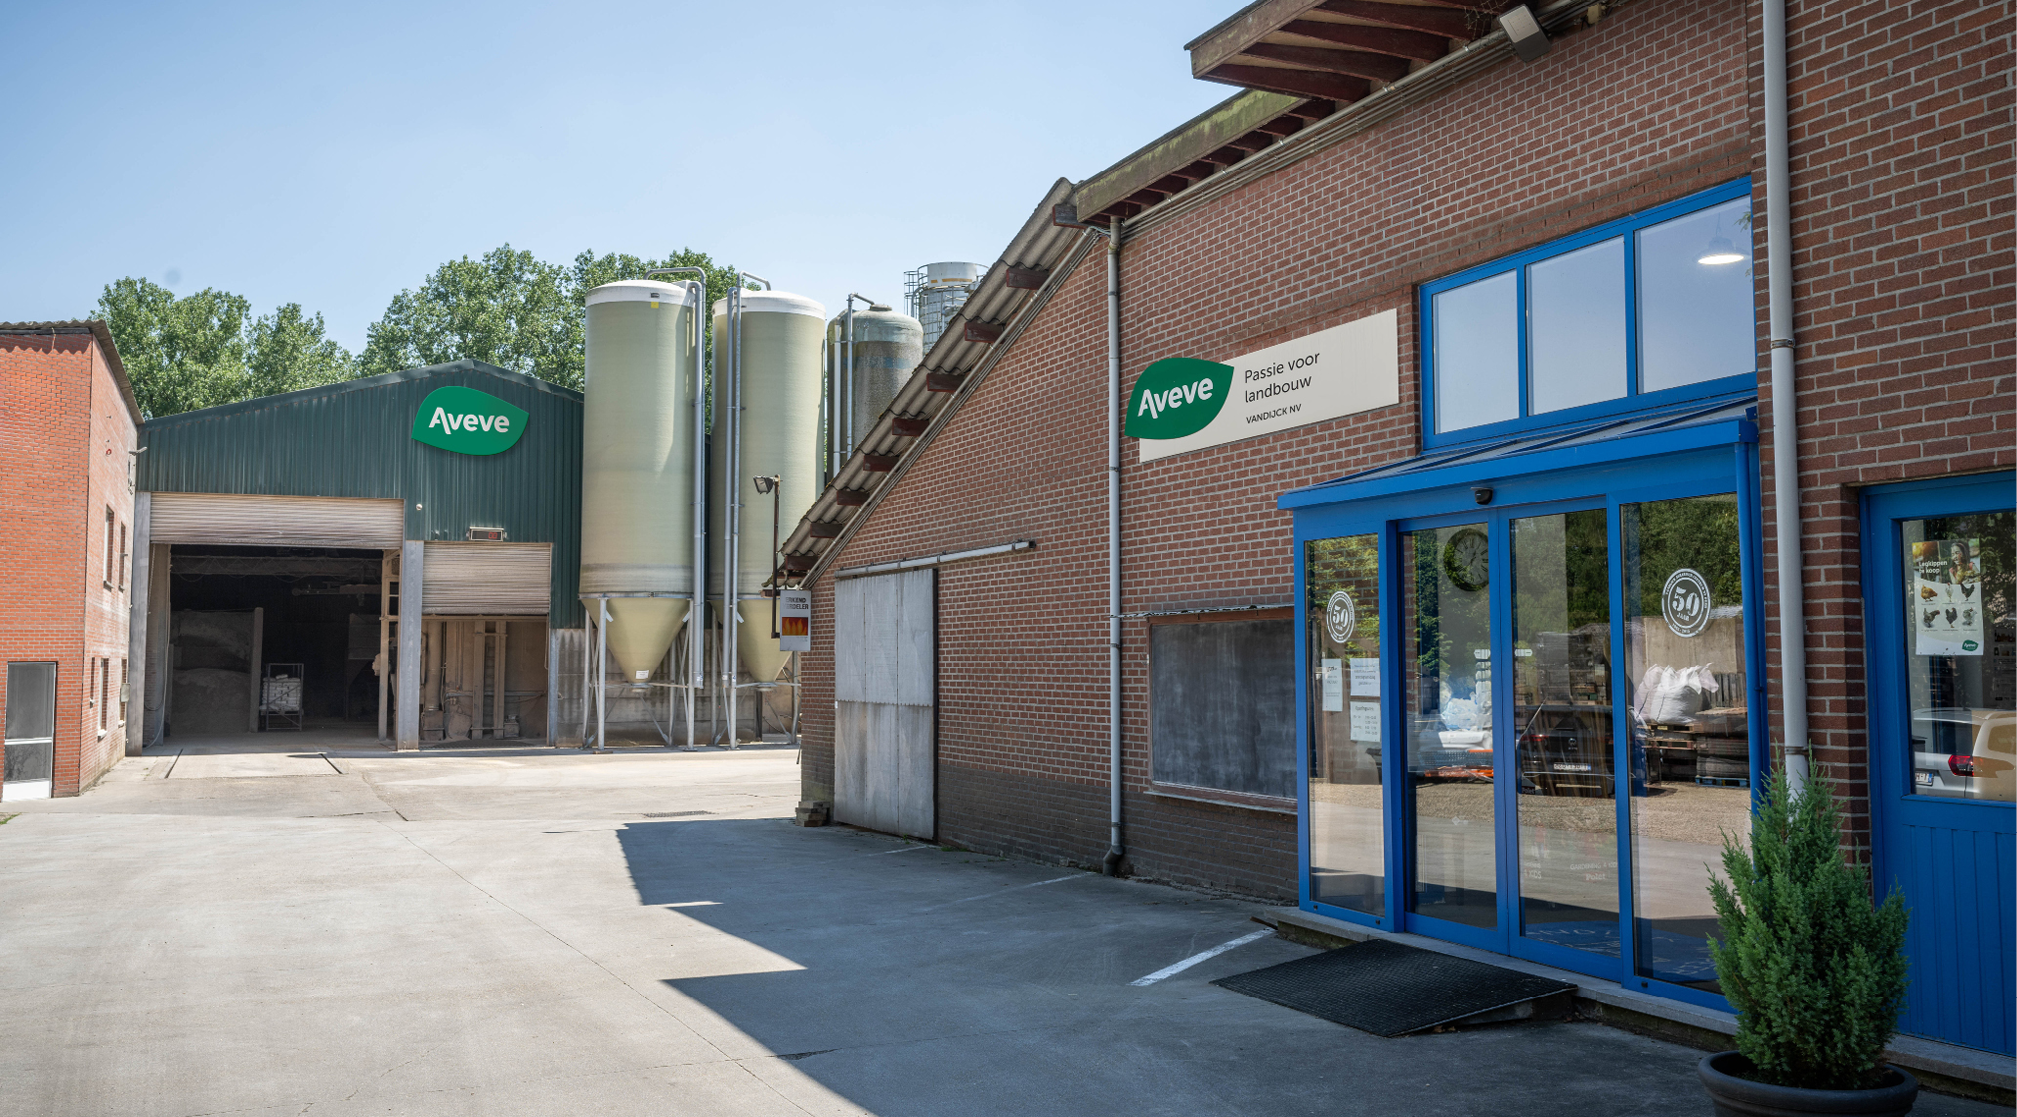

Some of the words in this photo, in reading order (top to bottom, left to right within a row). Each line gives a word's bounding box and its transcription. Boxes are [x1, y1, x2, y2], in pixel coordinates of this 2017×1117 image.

[1245, 363, 1284, 383] Passie
[1288, 353, 1320, 371] voor
[1138, 378, 1213, 419] Aveve
[1245, 376, 1312, 403] landbouw
[429, 407, 509, 434] Aveve
[1246, 407, 1287, 424] VANDIJCK
[1289, 404, 1302, 413] NV
[1672, 586, 1700, 616] 50
[1332, 605, 1348, 627] 50
